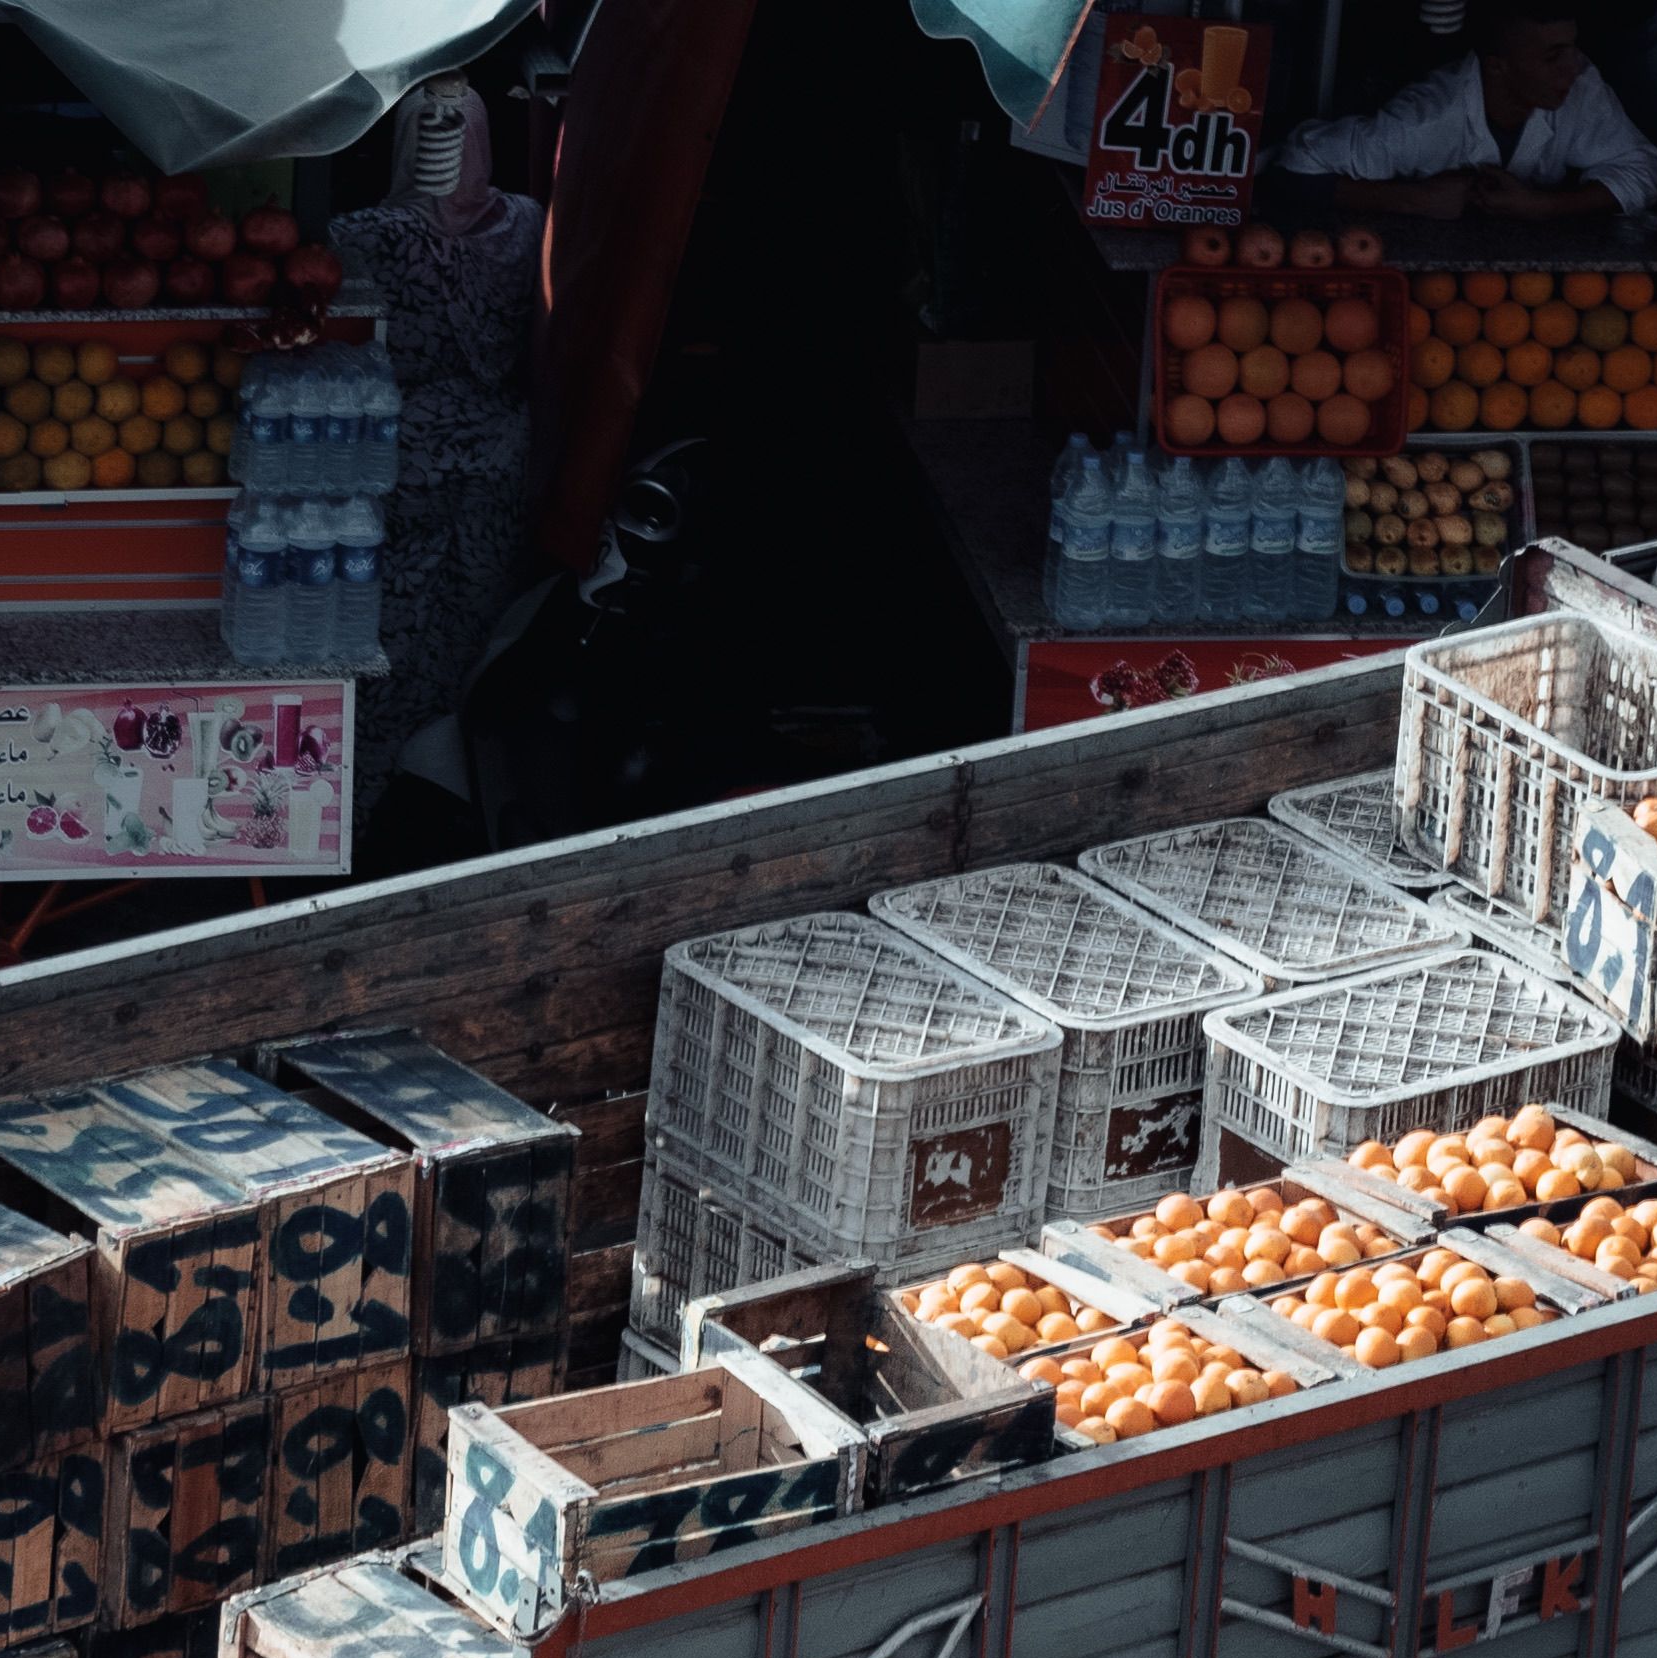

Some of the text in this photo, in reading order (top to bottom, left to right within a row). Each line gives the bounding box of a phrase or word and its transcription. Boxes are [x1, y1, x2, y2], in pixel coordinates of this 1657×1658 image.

[1100, 63, 1251, 177] 4dh
[1087, 197, 1126, 218] Jus
[1097, 172, 1238, 201] عصير البرتقال
[1293, 1575, 1337, 1636] H
[1436, 1552, 1583, 1652] LFK
